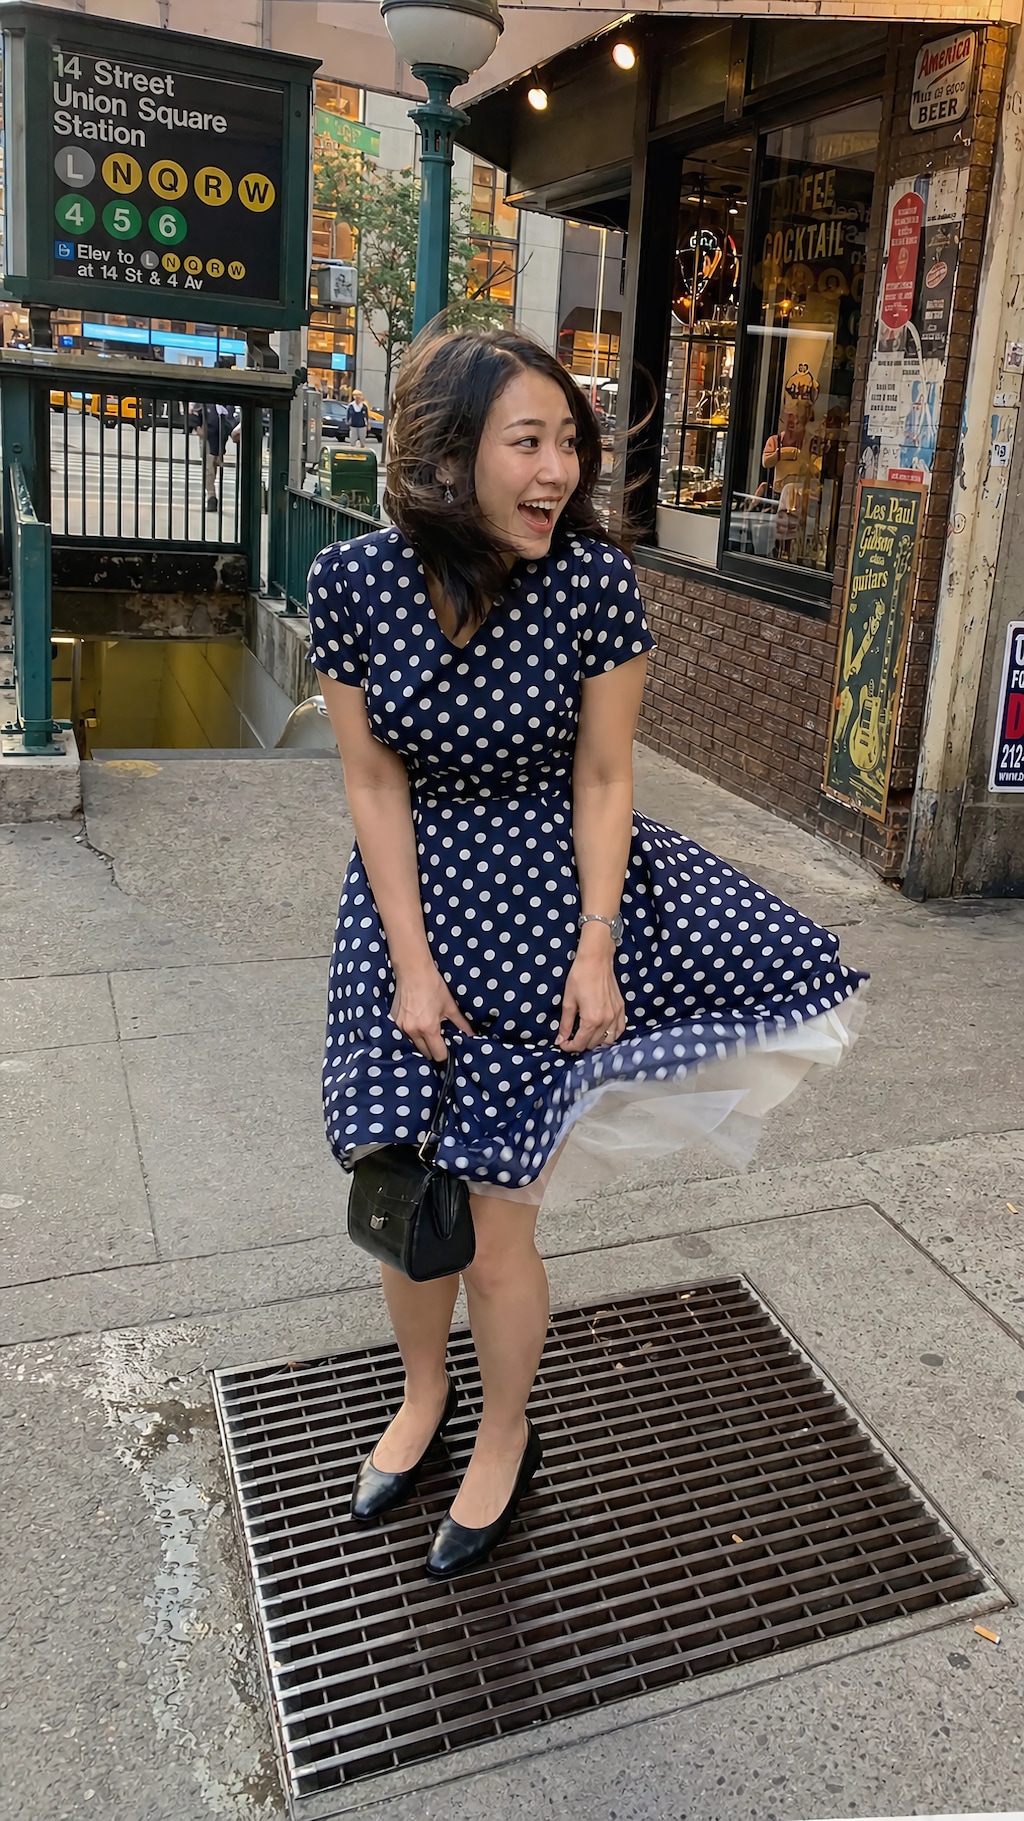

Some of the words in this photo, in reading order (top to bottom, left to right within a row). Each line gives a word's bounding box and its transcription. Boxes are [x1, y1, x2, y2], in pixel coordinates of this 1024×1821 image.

[53, 53, 82, 80] 14
[94, 60, 175, 97] Street
[53, 81, 127, 117] Union
[138, 97, 228, 133] Square
[917, 98, 958, 124] BEER
[53, 110, 146, 148] Station
[67, 154, 84, 180] L
[112, 161, 132, 186] N
[157, 167, 178, 193] Q
[204, 175, 222, 198] R
[244, 180, 269, 204] W
[64, 202, 84, 226] 4
[113, 208, 131, 232] 5
[158, 213, 177, 238] 6
[77, 243, 111, 262] Elev
[117, 249, 134, 265] to
[231, 265, 242, 276] W
[763, 221, 844, 264] COCKTAIL
[77, 263, 94, 278] at
[100, 265, 118, 280] 14
[125, 267, 143, 284] St
[149, 271, 161, 286] &
[166, 273, 178, 287] 4
[184, 275, 203, 290] Av
[864, 494, 887, 521] Les
[887, 497, 917, 525] Paul
[851, 568, 889, 599] guitars
